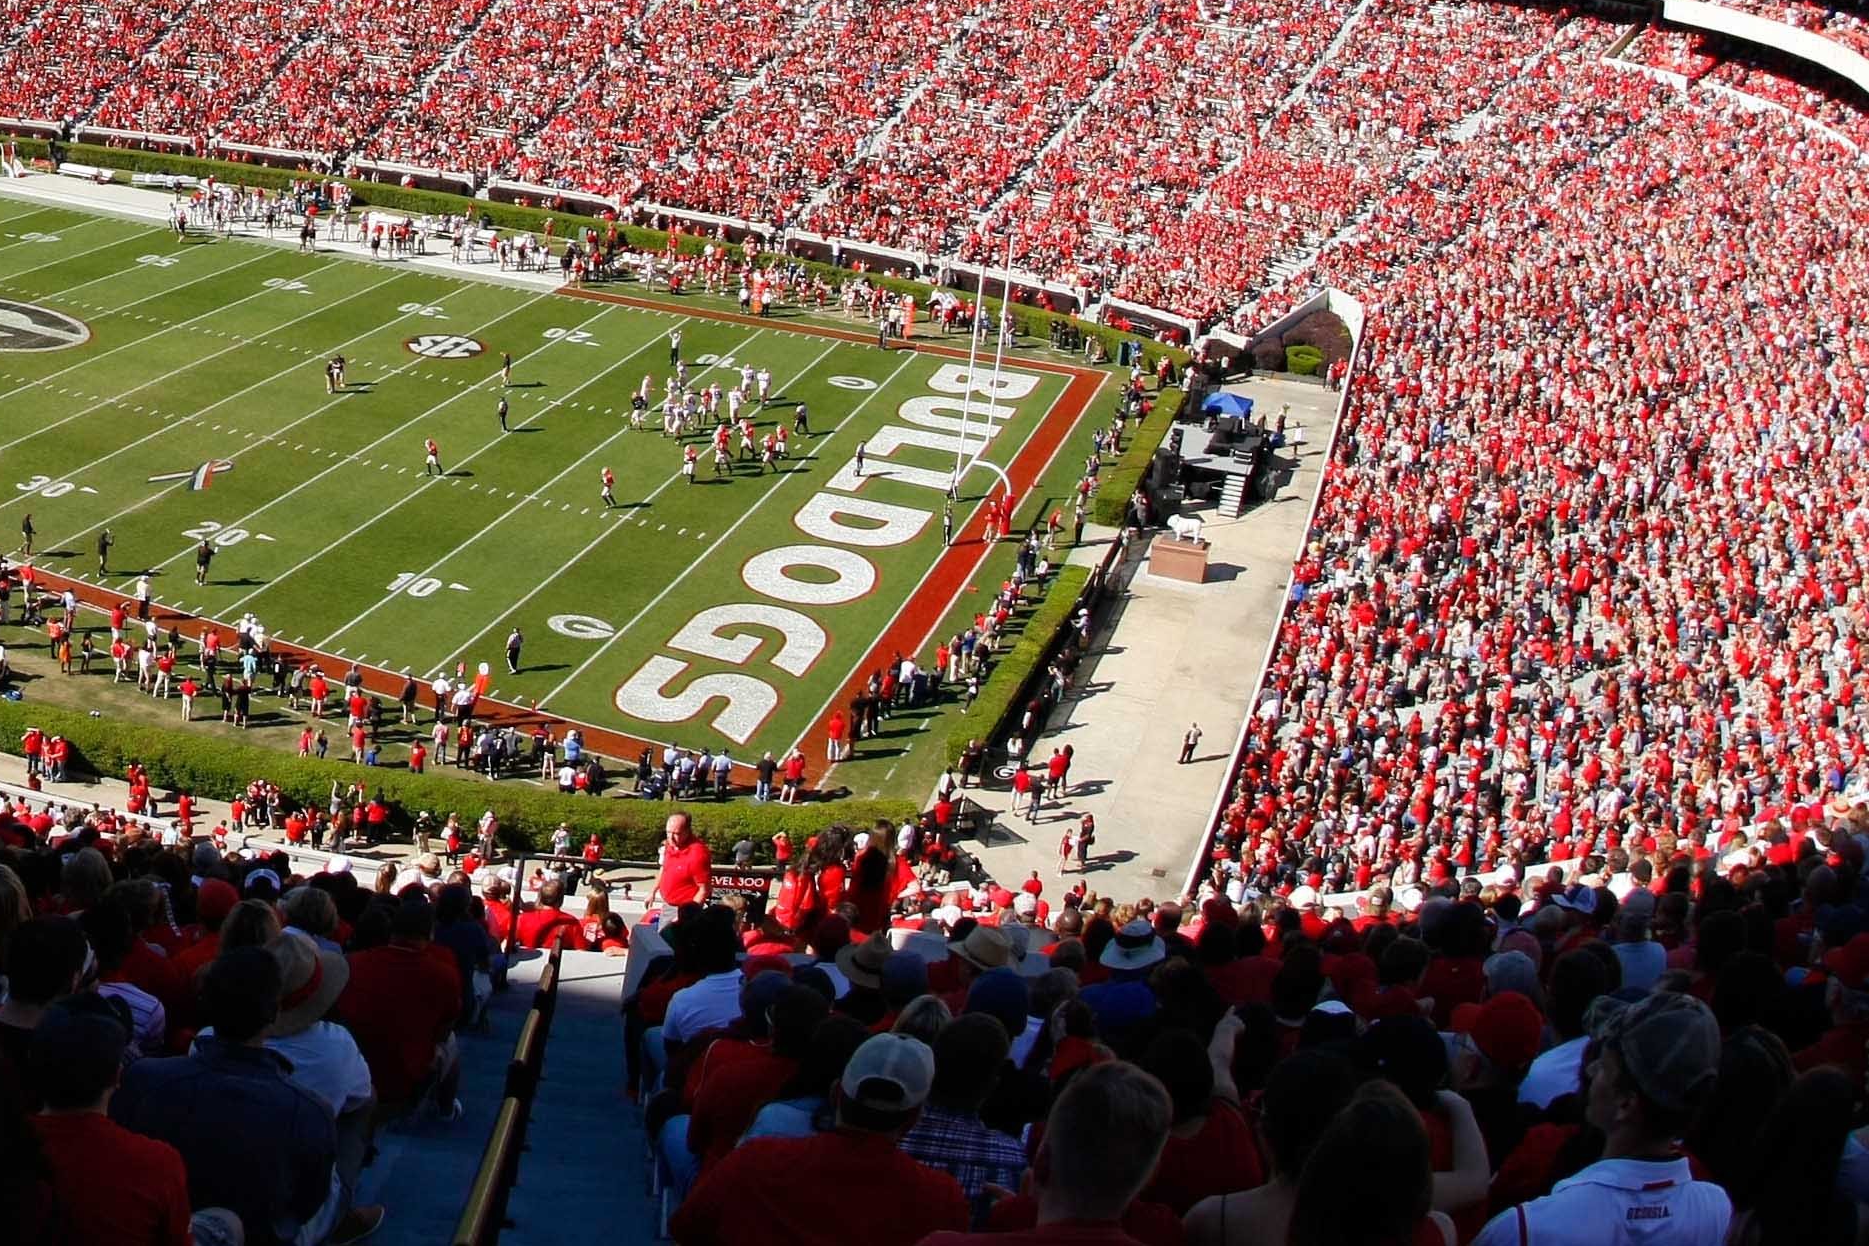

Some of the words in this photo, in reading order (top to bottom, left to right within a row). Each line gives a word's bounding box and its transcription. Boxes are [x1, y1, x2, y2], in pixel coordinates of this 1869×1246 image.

[135, 254, 180, 267] 50
[407, 335, 482, 358] SEC
[16, 475, 76, 498] 30
[182, 520, 251, 547] 20
[614, 362, 1042, 746] BULLDOGS
[385, 572, 444, 598] 10
[738, 877, 765, 888] 300
[1626, 1205, 1672, 1220] GEORGIA
